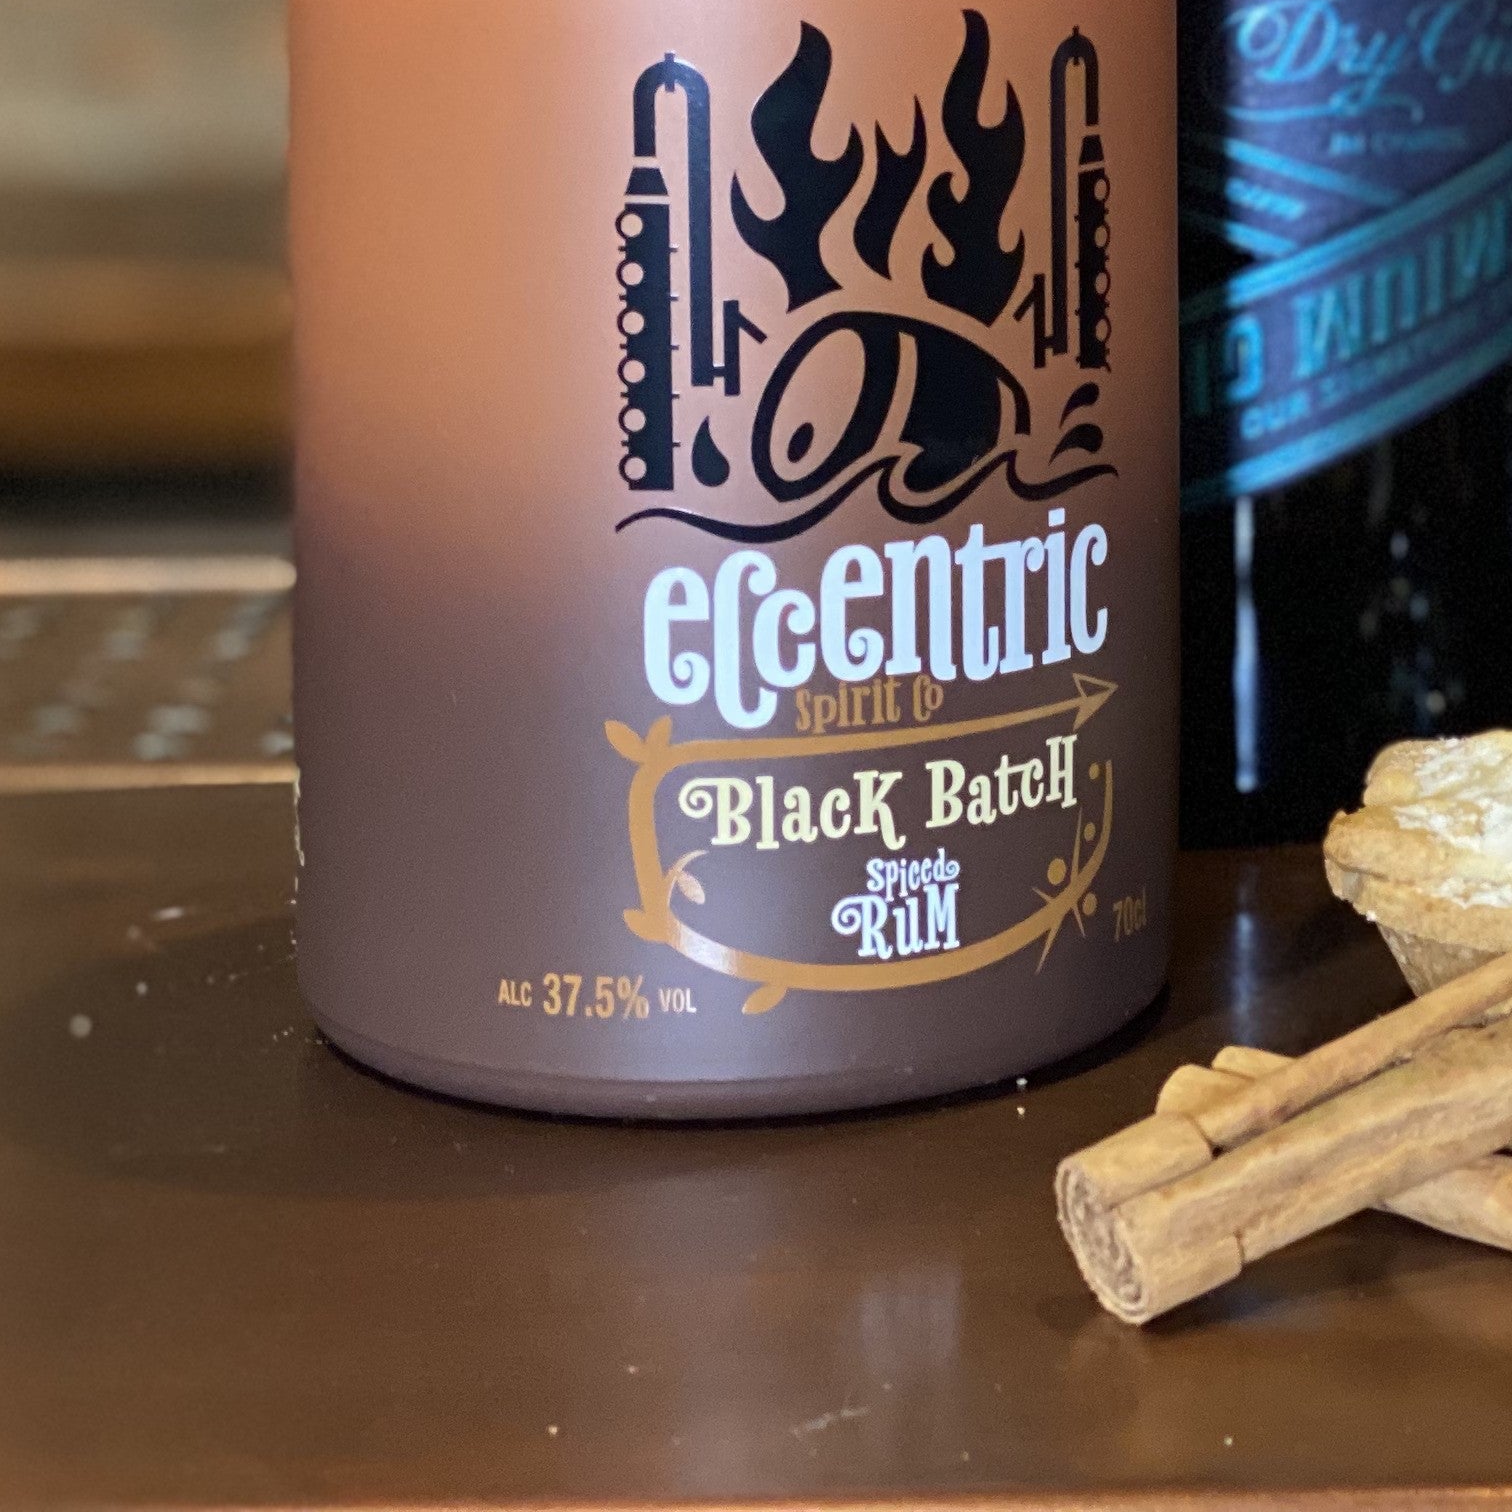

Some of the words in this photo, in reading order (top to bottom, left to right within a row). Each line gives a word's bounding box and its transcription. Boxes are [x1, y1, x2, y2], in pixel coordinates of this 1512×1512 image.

[642, 507, 1109, 729] eccentric
[795, 674, 902, 735] Spirit
[912, 673, 945, 723] Co
[865, 846, 962, 903] Spiced
[1111, 886, 1148, 943] 70cl
[497, 977, 533, 1008] ALC
[542, 971, 650, 1021] 37.5%
[658, 986, 698, 1015] VOL
